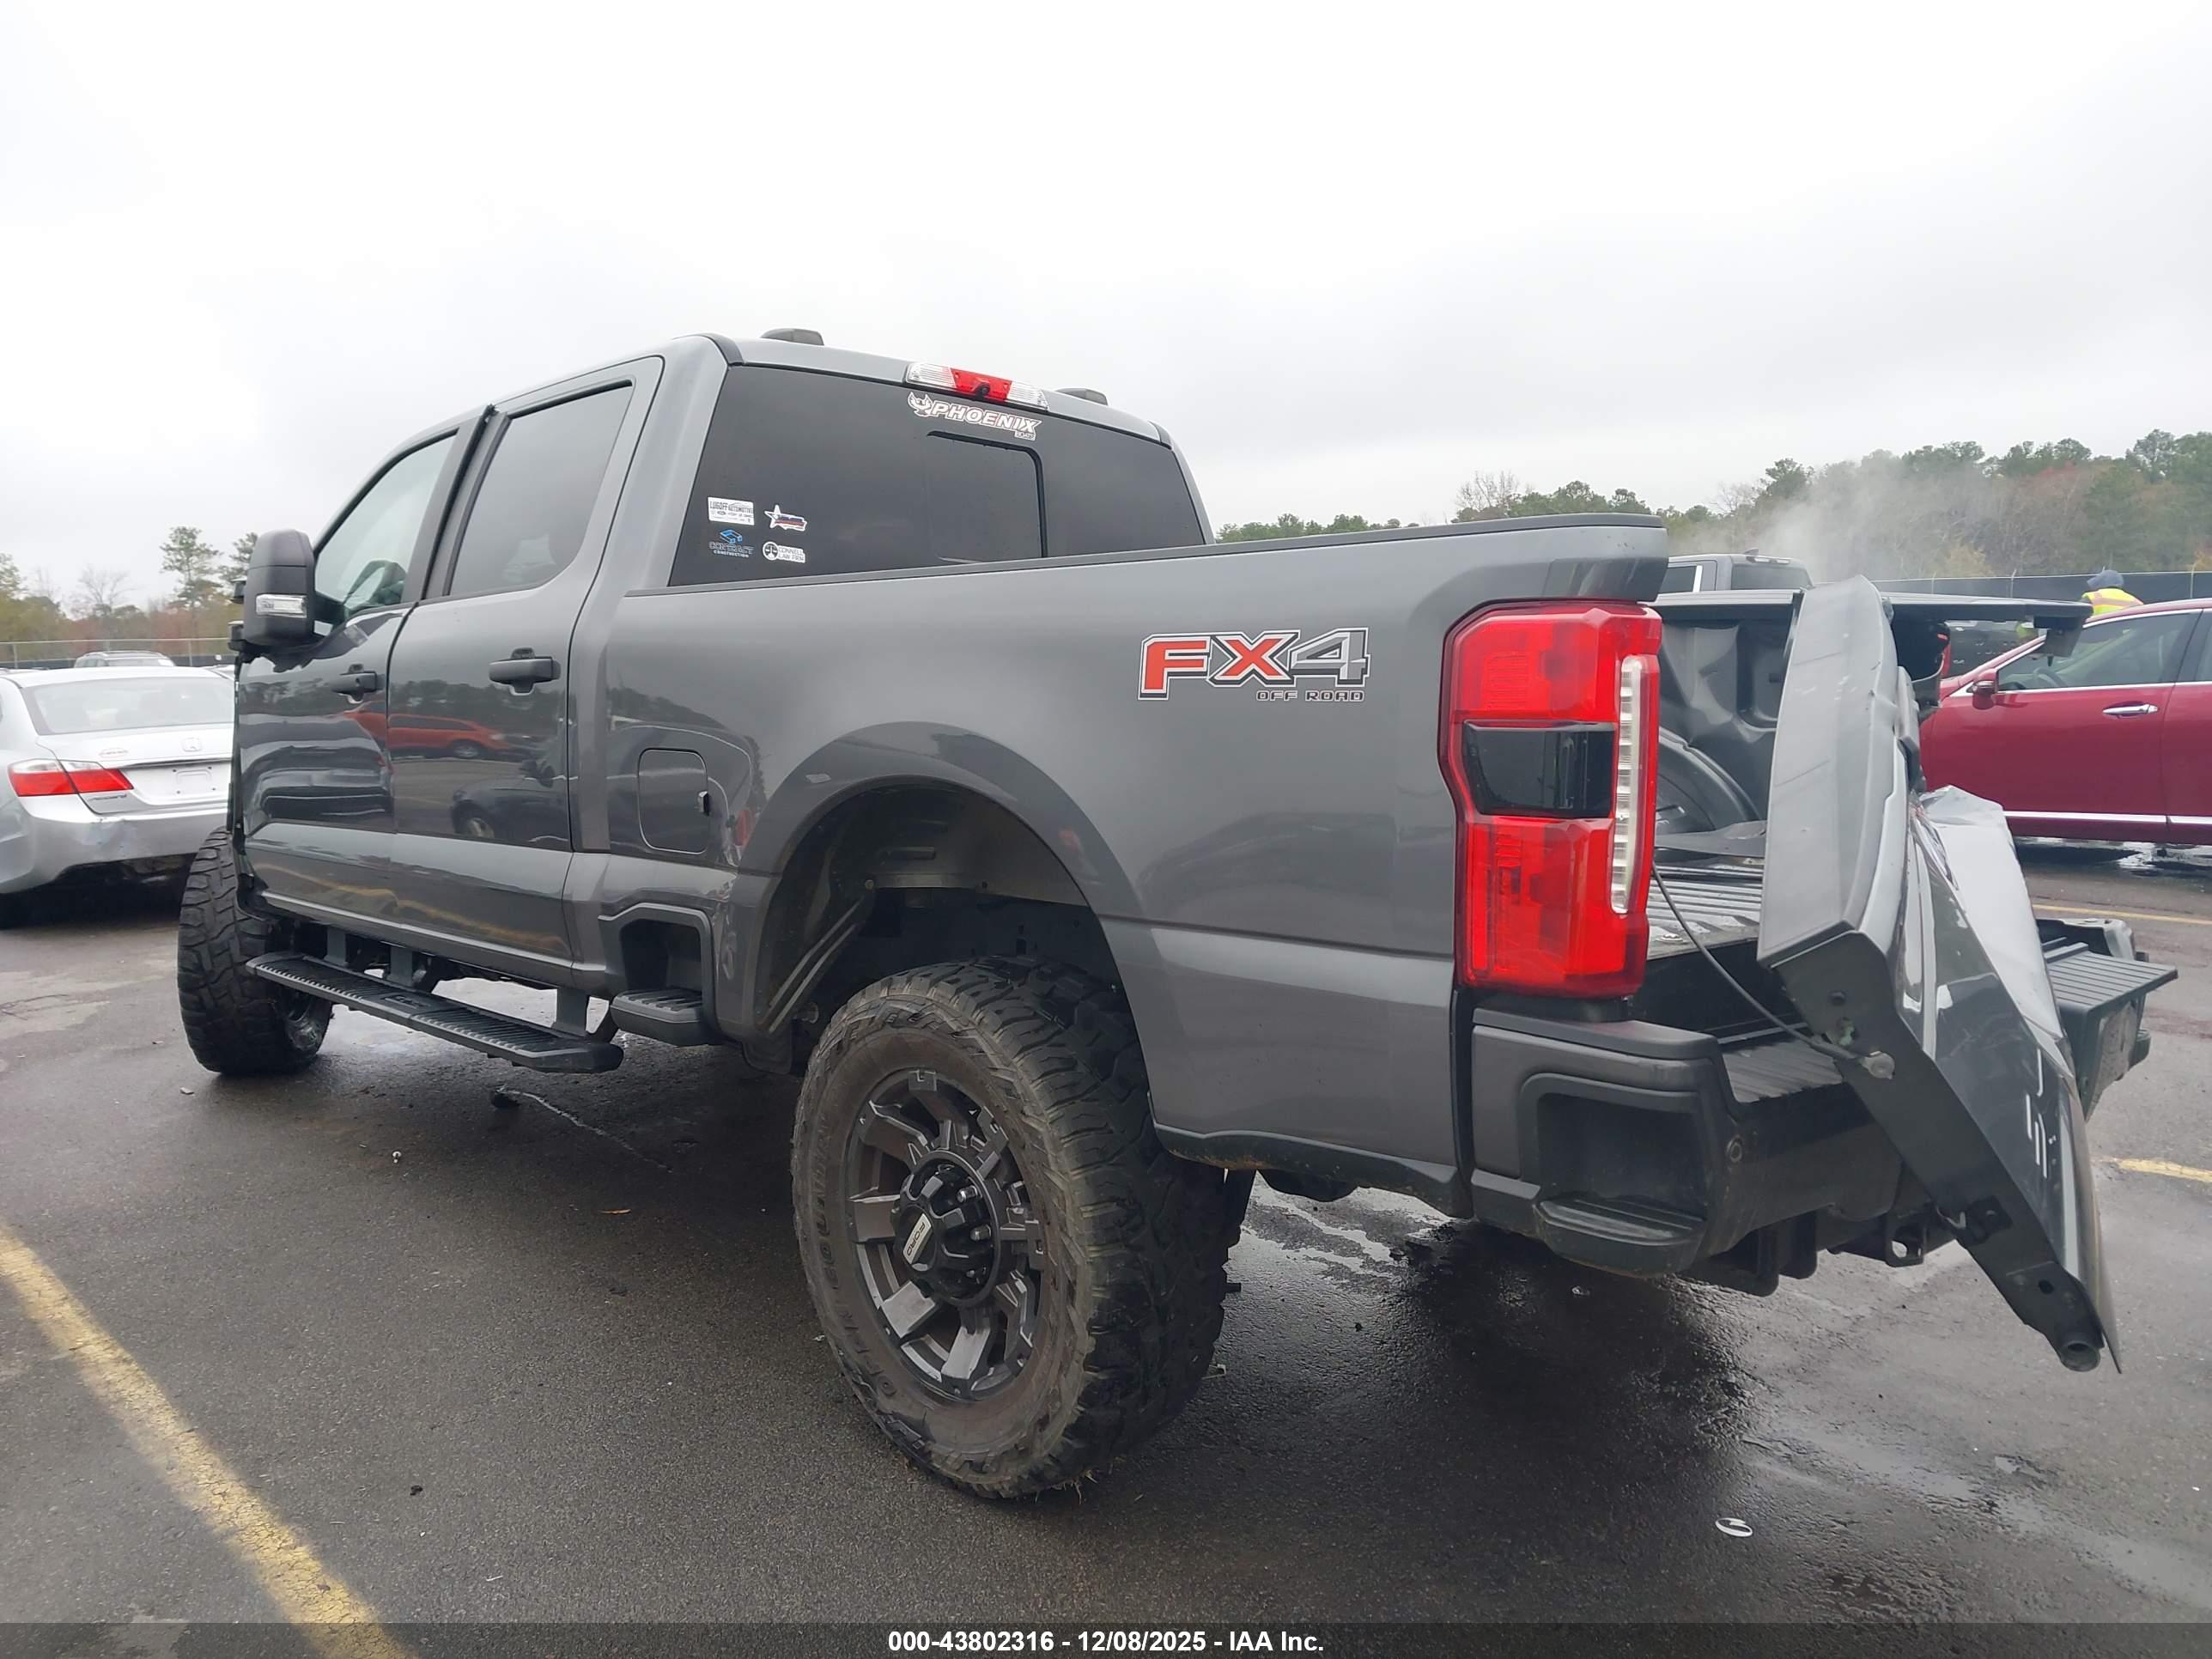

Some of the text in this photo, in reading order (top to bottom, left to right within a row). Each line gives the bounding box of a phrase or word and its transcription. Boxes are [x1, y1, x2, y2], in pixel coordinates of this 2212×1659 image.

[930, 400, 1042, 433] PHOENIX
[1138, 627, 1370, 701] FX4
[1255, 690, 1364, 702] OFF ROAD
[906, 1222, 926, 1256] FORD
